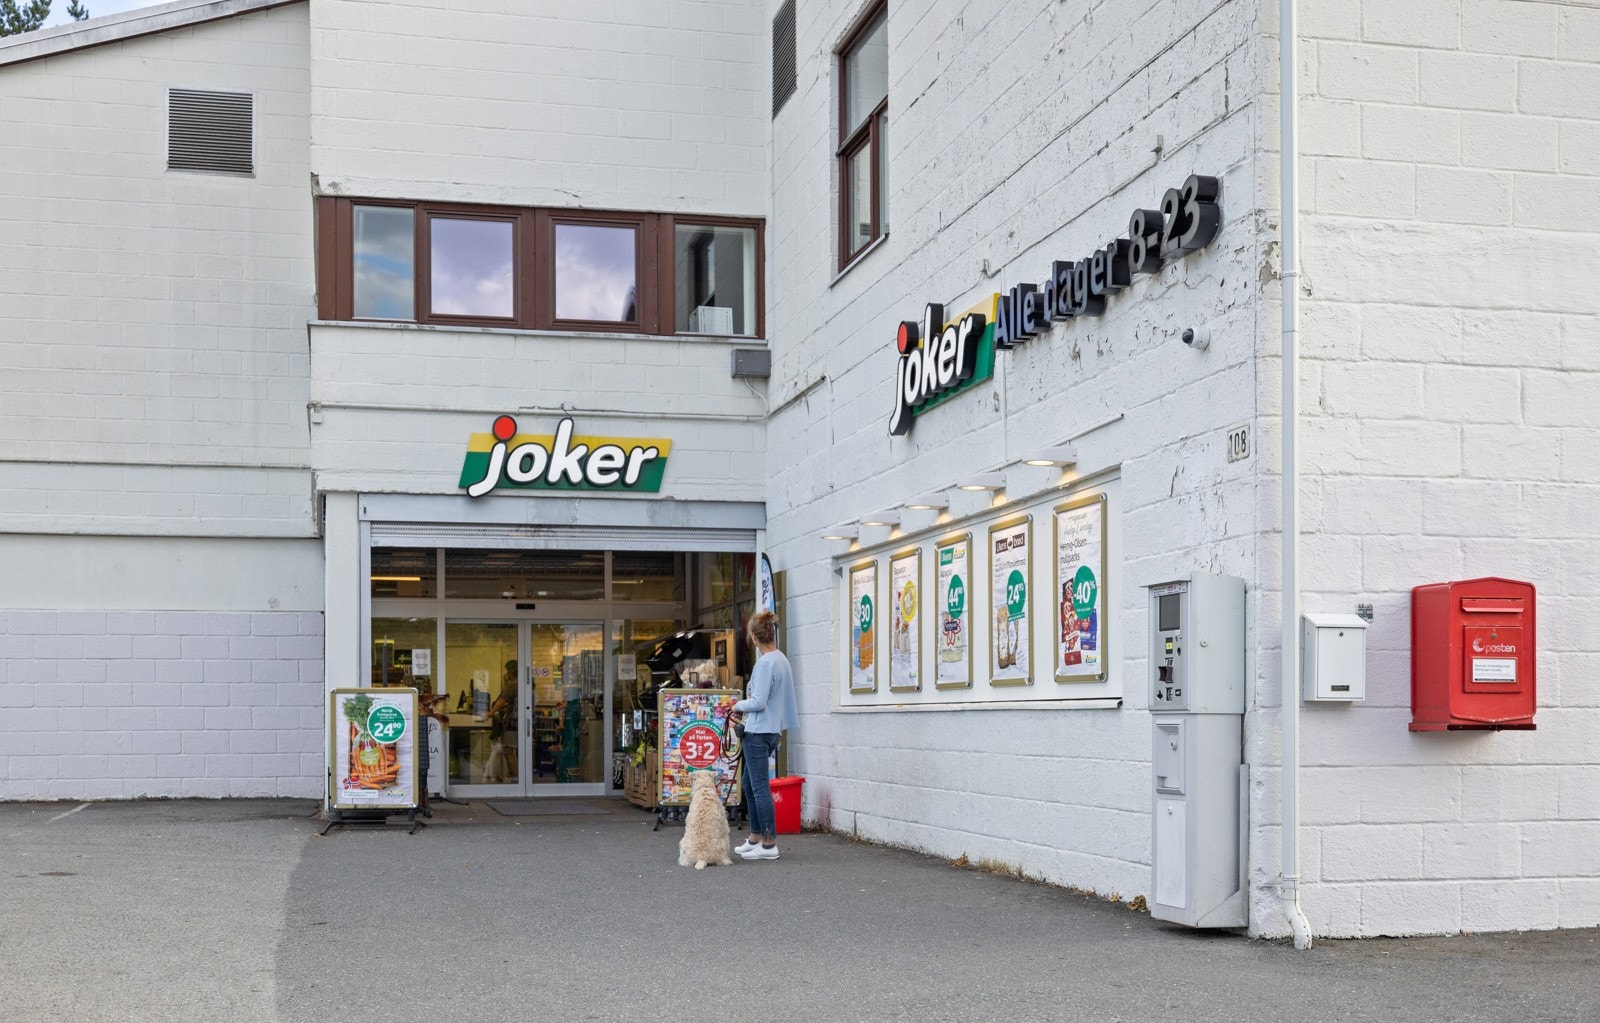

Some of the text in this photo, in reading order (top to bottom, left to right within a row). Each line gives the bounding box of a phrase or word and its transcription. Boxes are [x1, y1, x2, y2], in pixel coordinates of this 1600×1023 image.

[994, 174, 1220, 349] Alle dager 8-23
[889, 303, 984, 436] joker
[467, 415, 660, 497] joker
[1229, 429, 1247, 454] 108
[1485, 643, 1516, 654] posten
